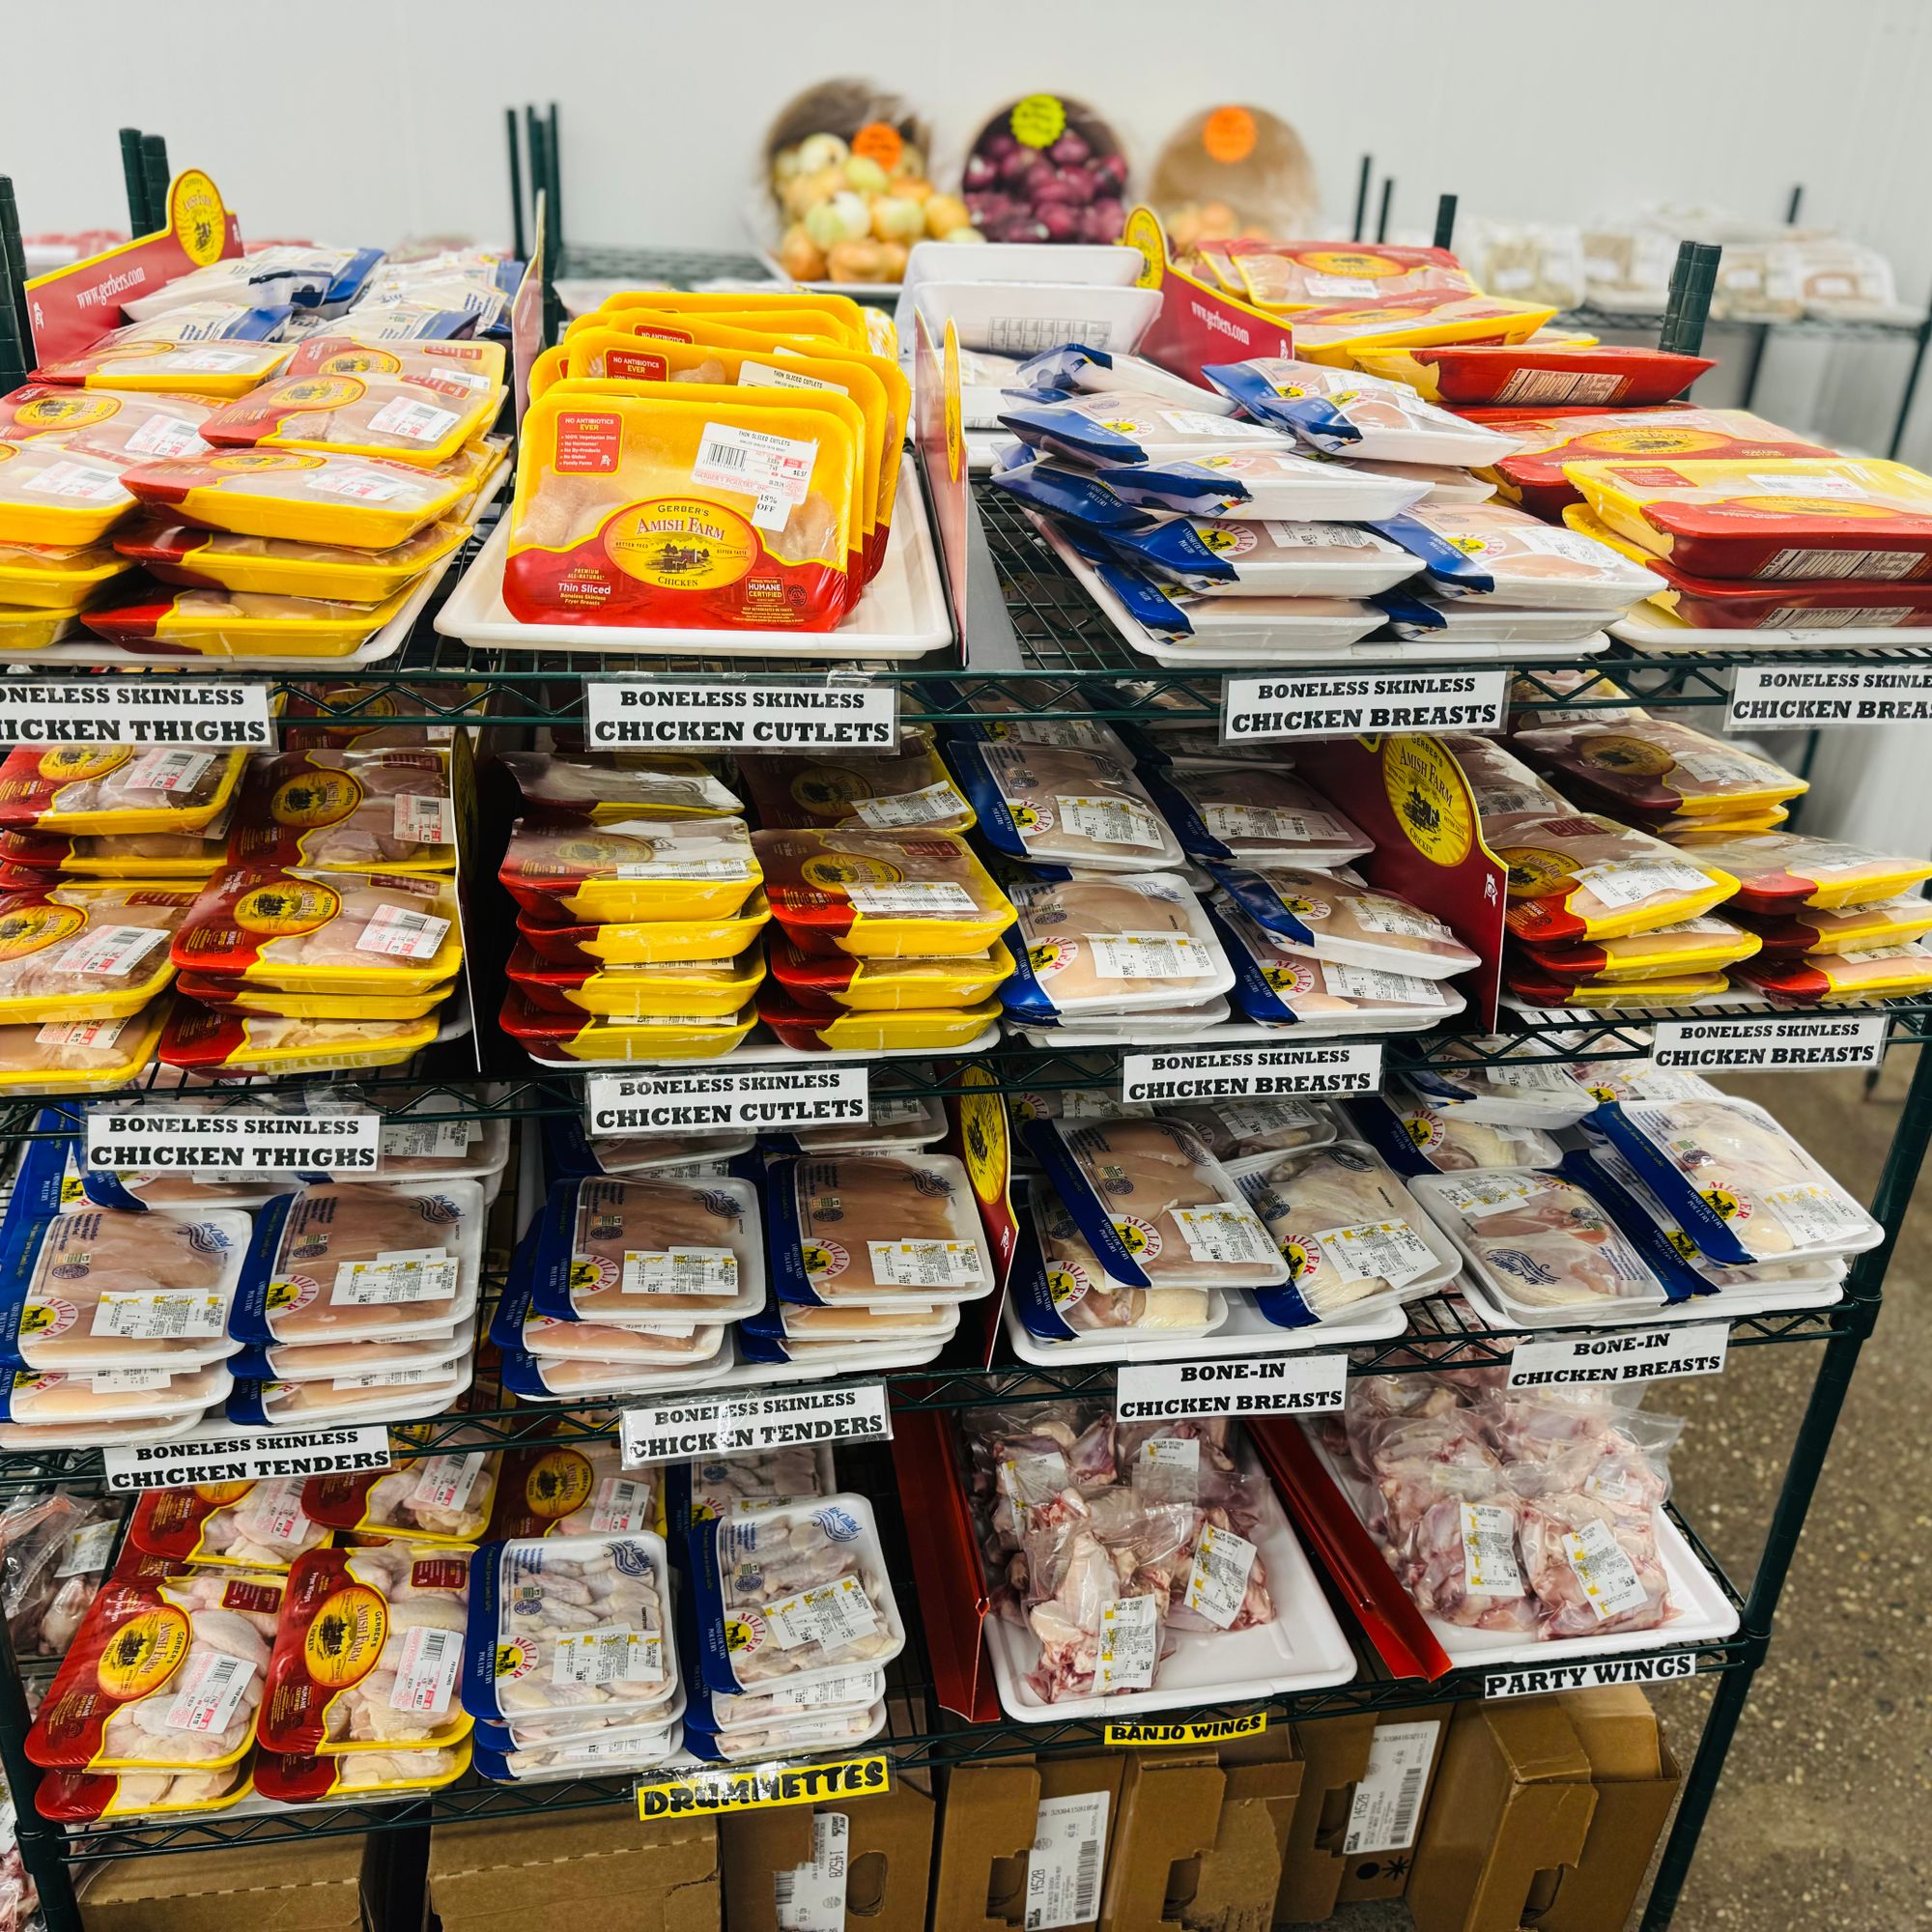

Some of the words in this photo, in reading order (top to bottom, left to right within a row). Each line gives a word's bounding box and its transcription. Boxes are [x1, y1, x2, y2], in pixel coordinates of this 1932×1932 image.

[76, 266, 145, 310] www.gerbers.com
[1191, 300, 1250, 346] www.gerbers.com
[623, 358, 660, 369] ANTIBIOTICS
[627, 365, 646, 374] EVER
[657, 504, 710, 517] GERBER'S
[757, 502, 776, 513] OFF
[760, 494, 778, 504] 15%
[636, 518, 684, 534] AMISH
[687, 516, 724, 541] FARM
[1211, 520, 1258, 556] MILLER
[557, 582, 579, 593] Thin
[581, 583, 611, 595] Sliced
[658, 575, 698, 586] CHICKEN
[748, 582, 781, 591] HUMANE
[1259, 681, 1369, 698] BONELESS
[1375, 678, 1475, 695] SKINLESS
[1759, 674, 1860, 687] BONELESS
[117, 689, 243, 704] SKINLESS
[621, 692, 747, 706] BONELESS
[753, 693, 864, 708] SKINLESS
[1733, 700, 1852, 719] CHICKEN
[1857, 701, 1932, 719] BREA
[0, 720, 120, 740] ICKEN
[129, 721, 265, 741] THIGHS
[595, 722, 744, 741] CHICKEN
[753, 722, 889, 742] CUTLETS
[1233, 709, 1363, 732] CHICKEN
[1370, 704, 1496, 727] BREASTS
[1411, 735, 1443, 767] GERBER'S
[1400, 747, 1428, 774] AMISH
[1428, 763, 1454, 808] FARM
[1020, 799, 1048, 833] MILLER
[1409, 827, 1435, 856] CHICKEN
[1293, 894, 1330, 919] MILLER
[1042, 936, 1077, 970] MILLER
[1273, 959, 1312, 995] MILLER
[1680, 1026, 1773, 1038] BONELESS
[1776, 1024, 1860, 1037] SKINLESS
[1152, 1054, 1253, 1070] BONELESS
[1258, 1050, 1350, 1065] SKINLESS
[1656, 1048, 1766, 1065] CHICKEN
[1771, 1046, 1874, 1063] BREASTS
[620, 1078, 733, 1095] BONELESS
[739, 1074, 839, 1091] SKINLESS
[1129, 1078, 1248, 1099] CHICKEN
[1255, 1073, 1370, 1093] BREASTS
[109, 1118, 238, 1133] BONELESS
[244, 1120, 358, 1134] SKINLESS
[597, 1105, 731, 1128] CHICKEN
[740, 1099, 863, 1121] CUTLETS
[1411, 1110, 1445, 1147] MILLER
[91, 1147, 243, 1167] CHICKEN
[253, 1149, 374, 1166] THIGHS
[1687, 1189, 1705, 1208] AMISH
[1699, 1205, 1725, 1230] COUNTRY
[1687, 1200, 1710, 1225] POULTRY
[1708, 1180, 1753, 1220] MILLER
[1124, 1214, 1161, 1257] MILLER
[816, 1239, 848, 1276] MILLER
[1283, 1235, 1320, 1275] MILLER
[586, 1255, 618, 1292] MILLER
[1059, 1261, 1089, 1304] MILLER
[287, 1274, 317, 1311] MILLER
[41, 1298, 78, 1336] MILLER
[1573, 1333, 1670, 1355] BONE-IN
[1181, 1363, 1285, 1381] BONE-IN
[1512, 1368, 1618, 1385] CHICKEN
[1623, 1356, 1721, 1378] BREASTS
[763, 1392, 855, 1413] SKINLESS
[1121, 1397, 1230, 1417] CHICKEN
[1236, 1391, 1342, 1411] BREASTS
[760, 1415, 882, 1444] TENDERS
[136, 1438, 250, 1461] BONELESS
[256, 1432, 357, 1450] SKINLESS
[112, 1463, 246, 1488] CHICKEN
[255, 1450, 388, 1476] TENDERS
[828, 1505, 863, 1534] Air-Chilled
[356, 1604, 370, 1633] AMISH
[370, 1610, 383, 1648] GERBER'S
[737, 1612, 767, 1653] MILLER
[156, 1622, 175, 1649] AMISH
[167, 1631, 185, 1664] GERBER'S
[308, 1624, 320, 1652] CHICKEN
[347, 1634, 370, 1662] FARM
[102, 1638, 119, 1663] CHICKEN
[140, 1646, 167, 1674] FARM
[512, 1636, 539, 1680] MILLER
[1486, 1666, 1585, 1697] PARTY
[1591, 1655, 1692, 1684] WINGS
[293, 1687, 302, 1712] CERTIFIED
[299, 1685, 310, 1709] HUMANE
[1111, 1723, 1187, 1742] BANJO
[1188, 1716, 1263, 1739] WINGS
[1352, 1793, 1370, 1820] 14528
[829, 1850, 844, 1879] 14528
[1030, 1868, 1045, 1896] 14528
